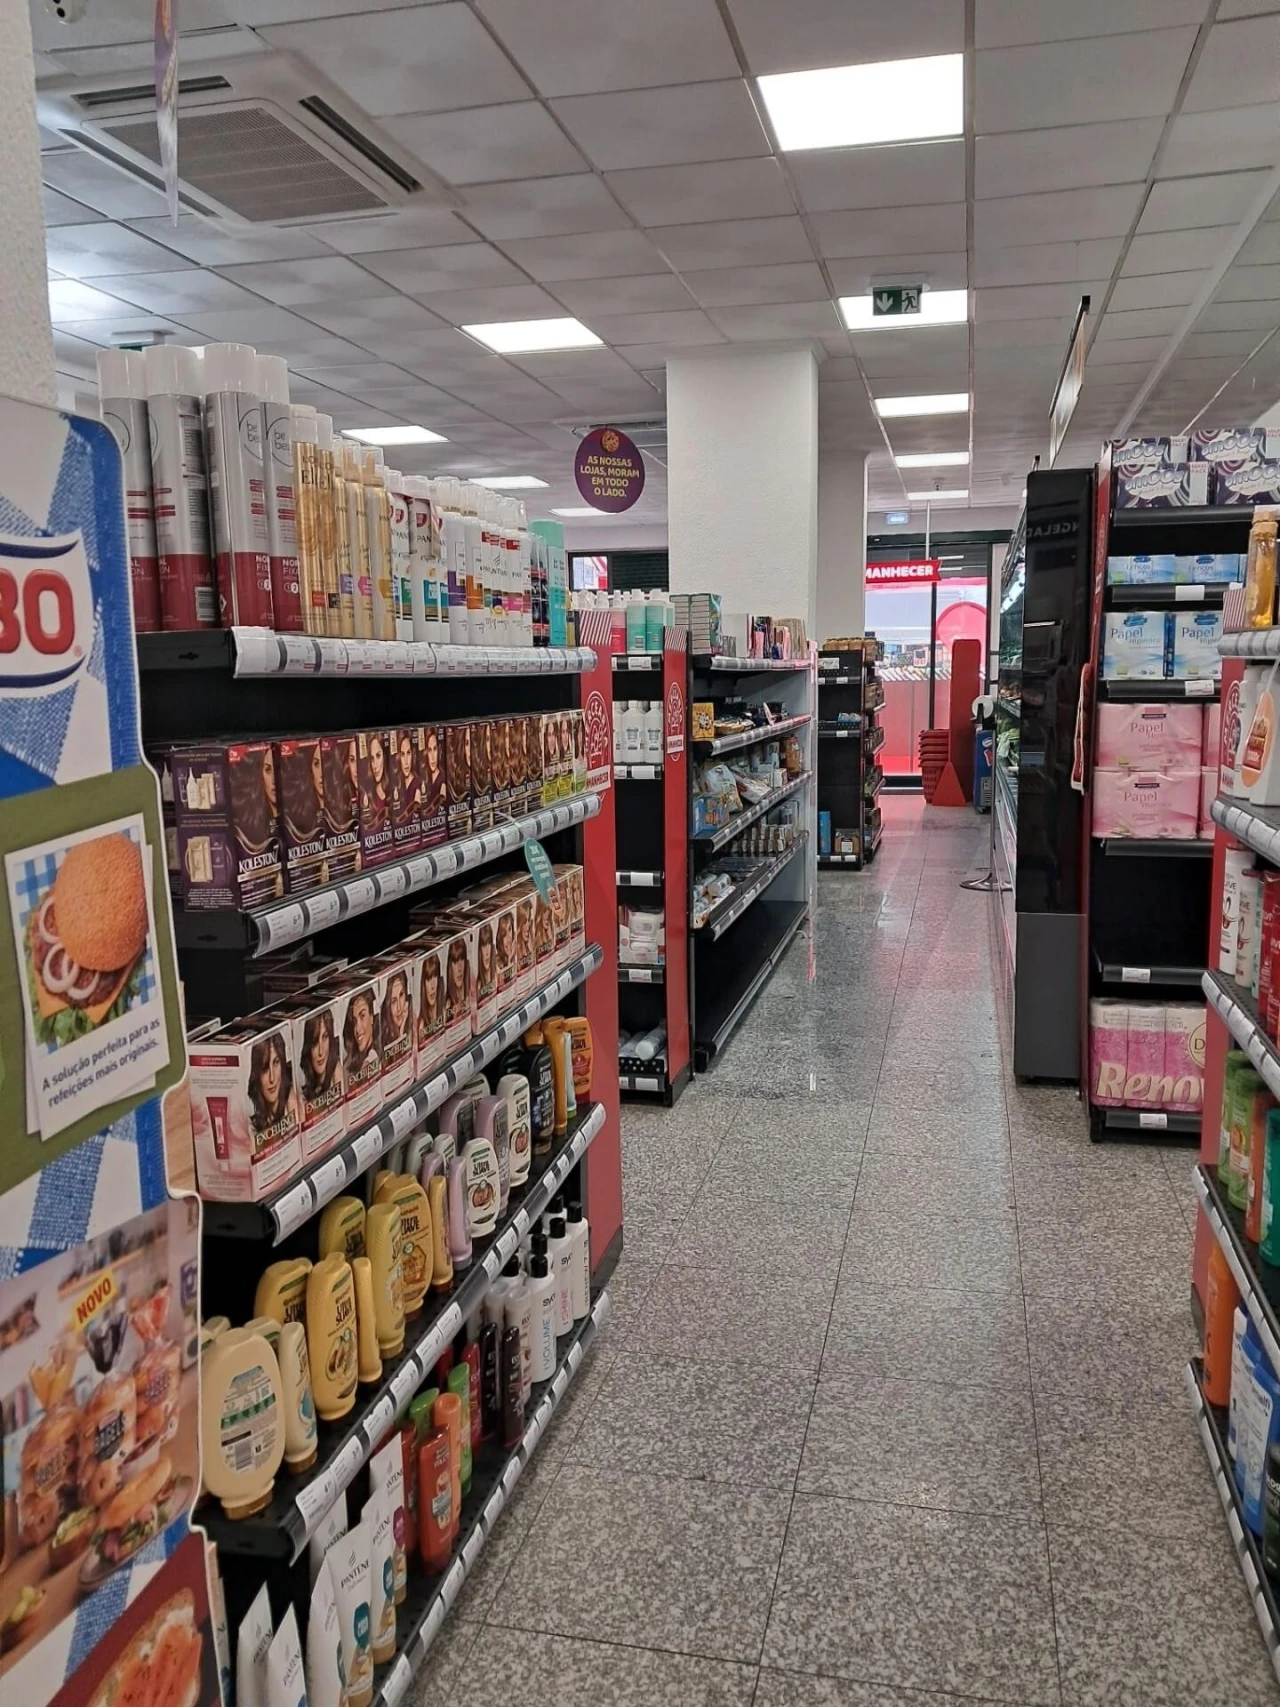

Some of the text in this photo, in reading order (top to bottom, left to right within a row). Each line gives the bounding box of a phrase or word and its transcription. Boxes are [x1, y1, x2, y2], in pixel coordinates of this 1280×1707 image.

[587, 455, 632, 467] AS NOSSAS
[580, 465, 640, 478] LOJAS, MORAM
[592, 477, 629, 487] EM TODO
[594, 487, 627, 497] O LADO.
[866, 565, 934, 579] MANHECER
[1111, 628, 1143, 641] Papel
[1181, 627, 1214, 640] Papel
[1130, 722, 1164, 735] Papel
[1124, 791, 1157, 804] Papel
[421, 815, 446, 832] KOLESTON
[364, 830, 392, 848] KOLESTON
[394, 824, 421, 840] KOLESTON
[42, 1018, 161, 1092] A solução perfeita para as
[348, 1060, 380, 1086] EXCELLENCE
[48, 1073, 95, 1108] refeições
[95, 1061, 119, 1081] mais
[1096, 1061, 1205, 1104] Reno
[306, 1084, 342, 1113] EXCELLENCE
[256, 1112, 297, 1145] EXCELLENCE
[75, 1277, 112, 1324] NOVO
